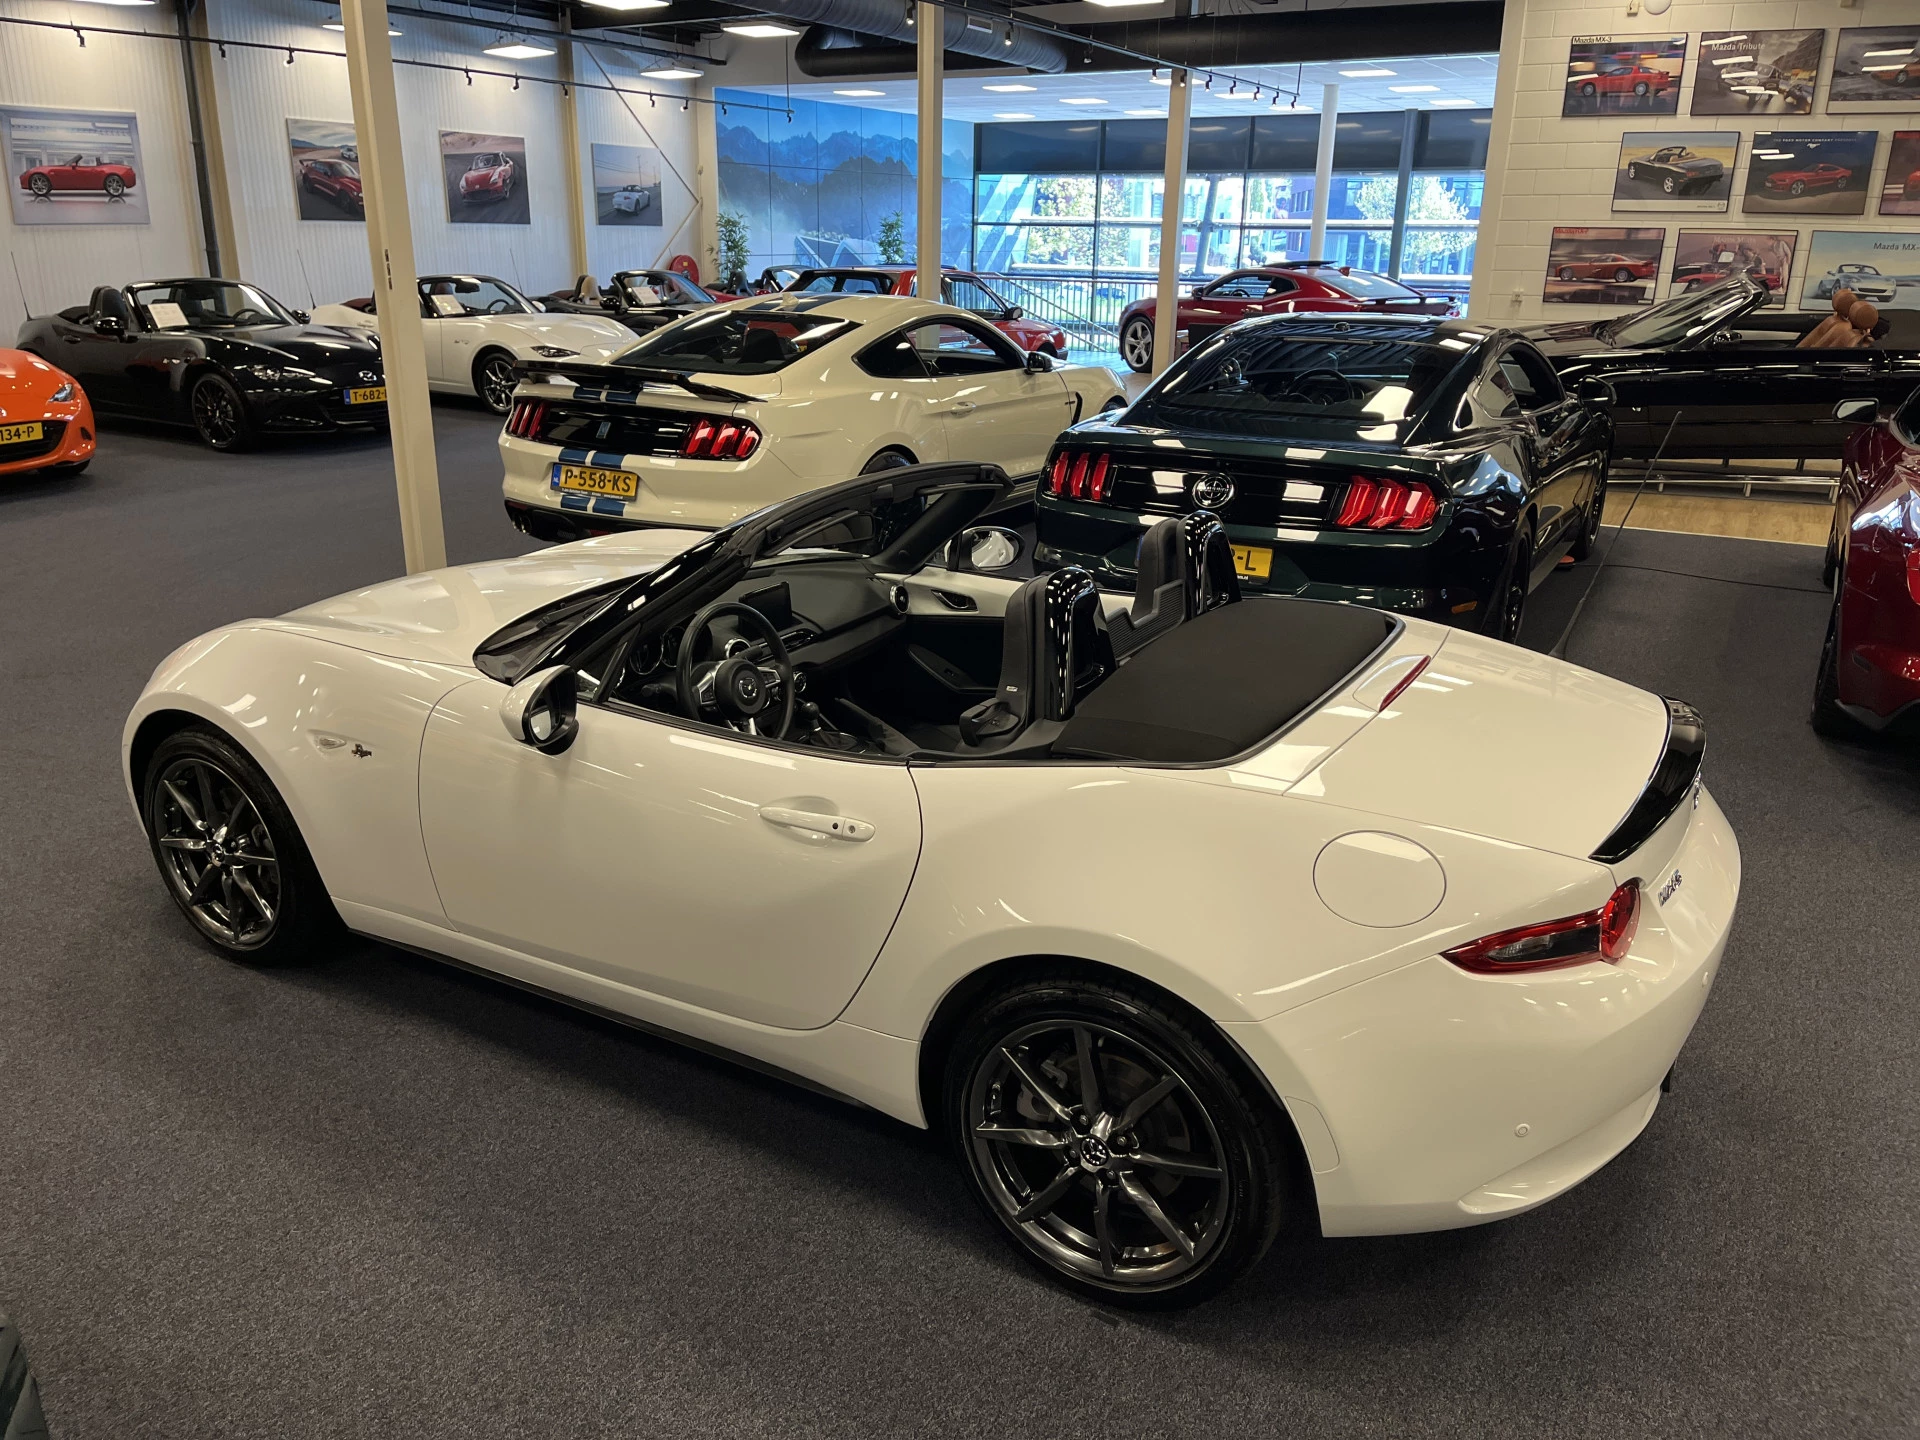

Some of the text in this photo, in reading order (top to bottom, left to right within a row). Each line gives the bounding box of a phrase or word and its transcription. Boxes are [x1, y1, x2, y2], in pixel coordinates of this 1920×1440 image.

[1711, 42, 1766, 51] Mazda Tribute
[1873, 242, 1900, 251] Mazda
[564, 468, 632, 493] P-558-KS
